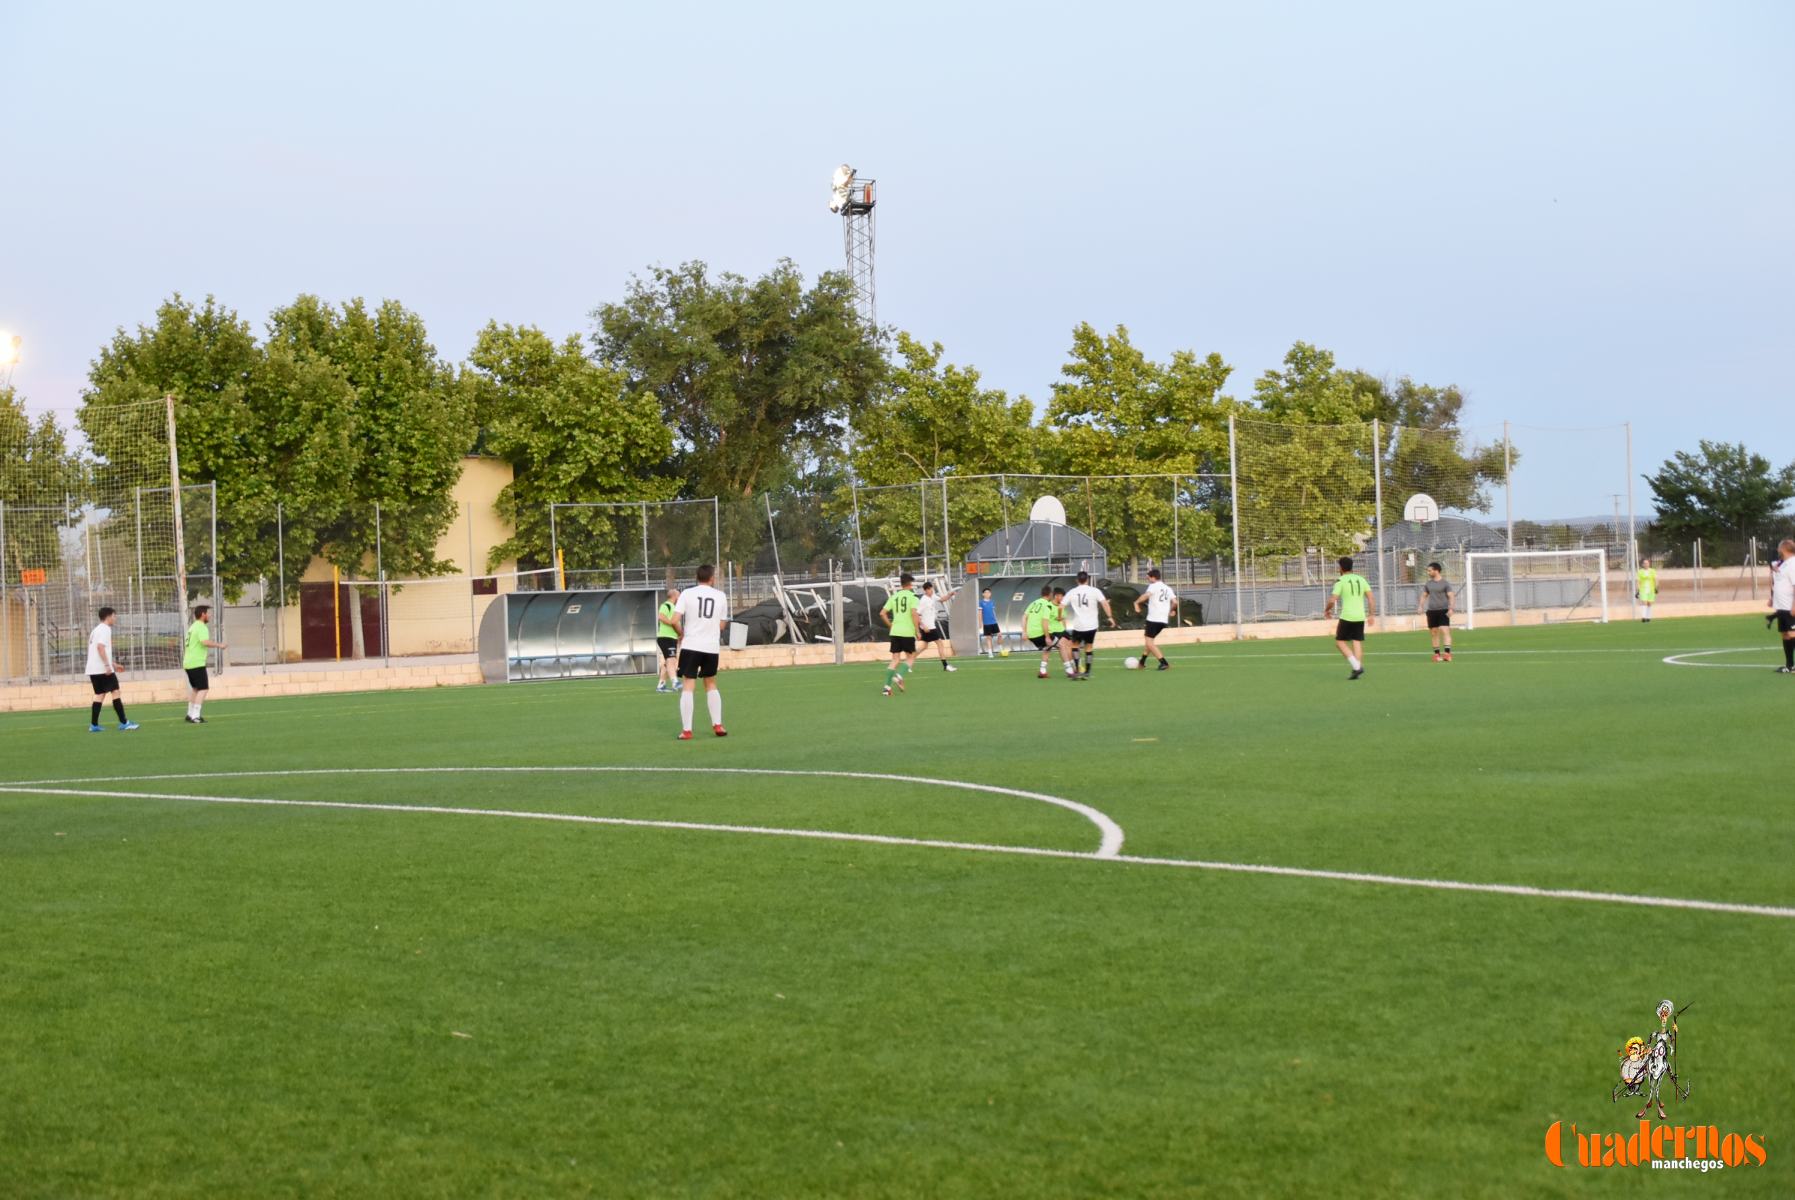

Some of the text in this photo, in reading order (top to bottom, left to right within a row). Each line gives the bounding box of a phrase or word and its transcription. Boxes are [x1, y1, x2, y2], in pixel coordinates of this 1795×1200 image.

[1348, 579, 1361, 596] 11
[697, 596, 715, 619] 10
[895, 596, 907, 614] 19
[1077, 593, 1089, 608] 14
